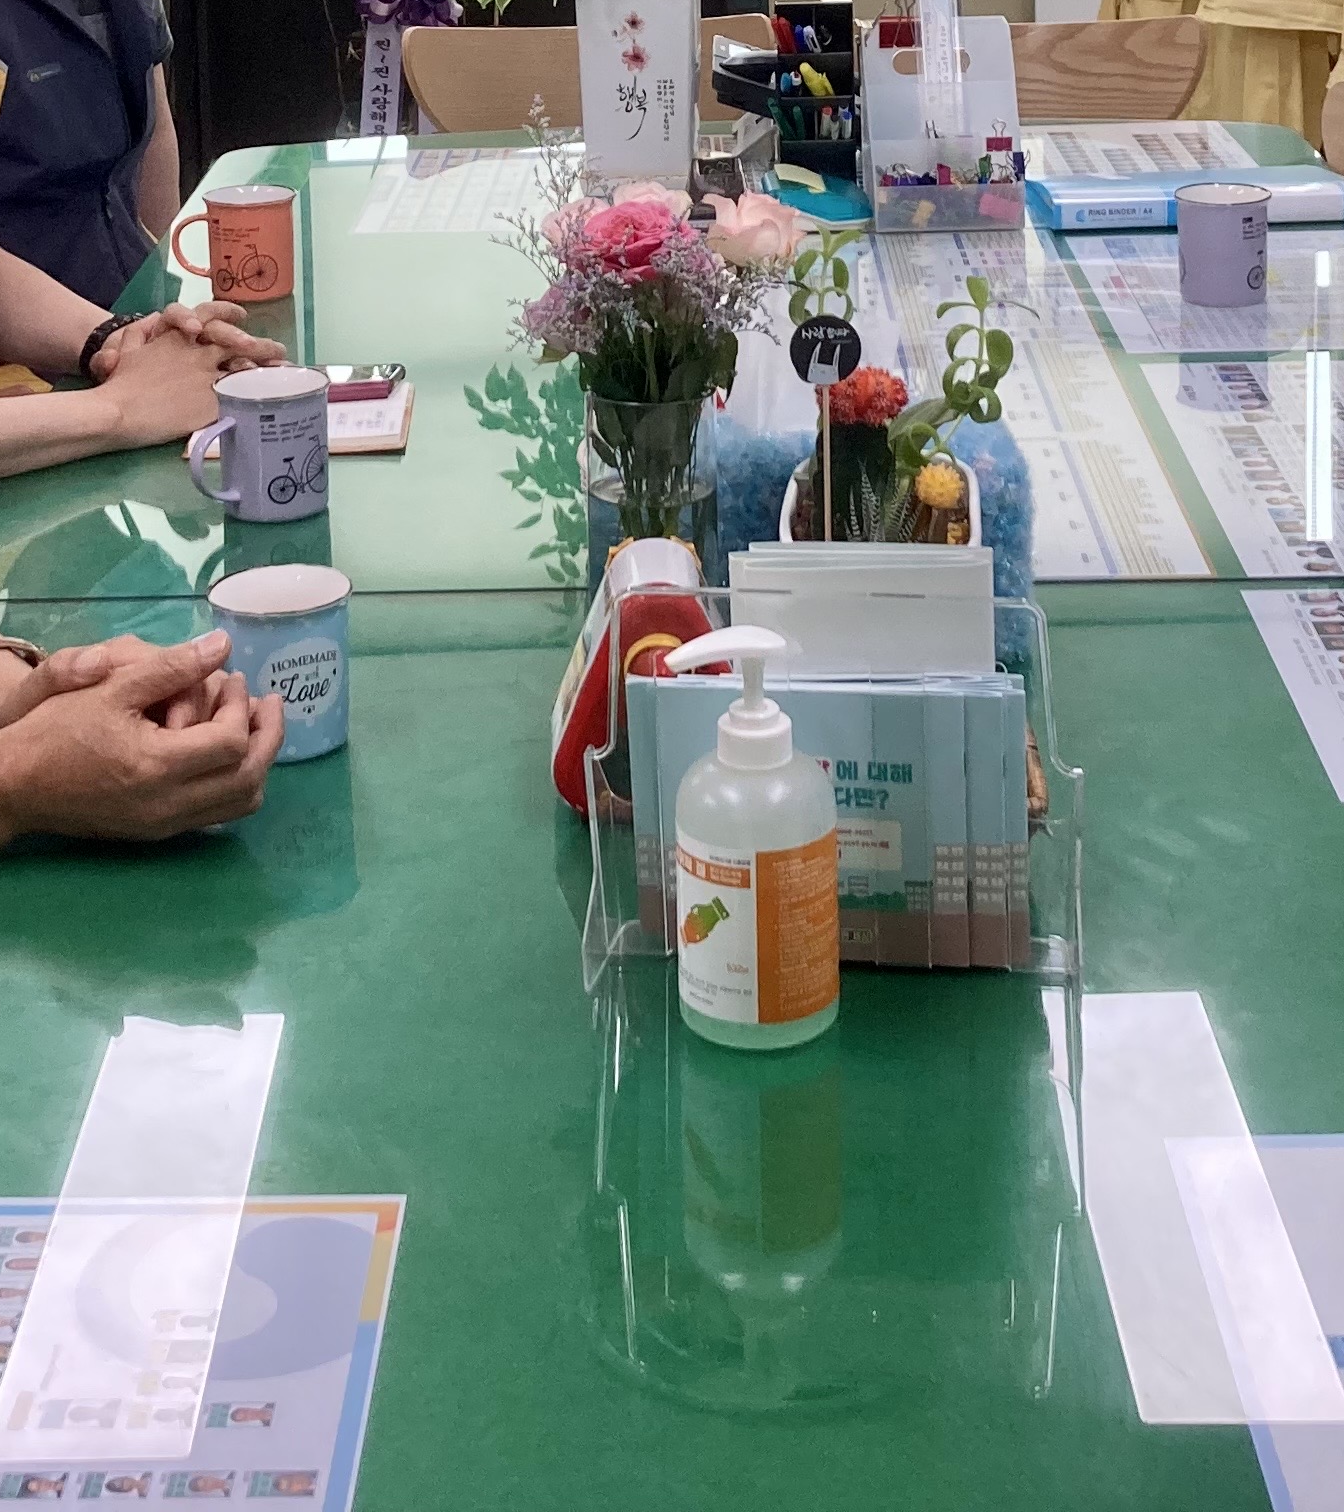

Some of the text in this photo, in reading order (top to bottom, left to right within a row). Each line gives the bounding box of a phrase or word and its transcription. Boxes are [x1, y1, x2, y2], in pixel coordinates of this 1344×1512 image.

[615, 75, 649, 141] 행복
[1088, 207, 1153, 216] RING BINDER A4
[280, 673, 332, 703] Love
[867, 761, 913, 783] 대해
